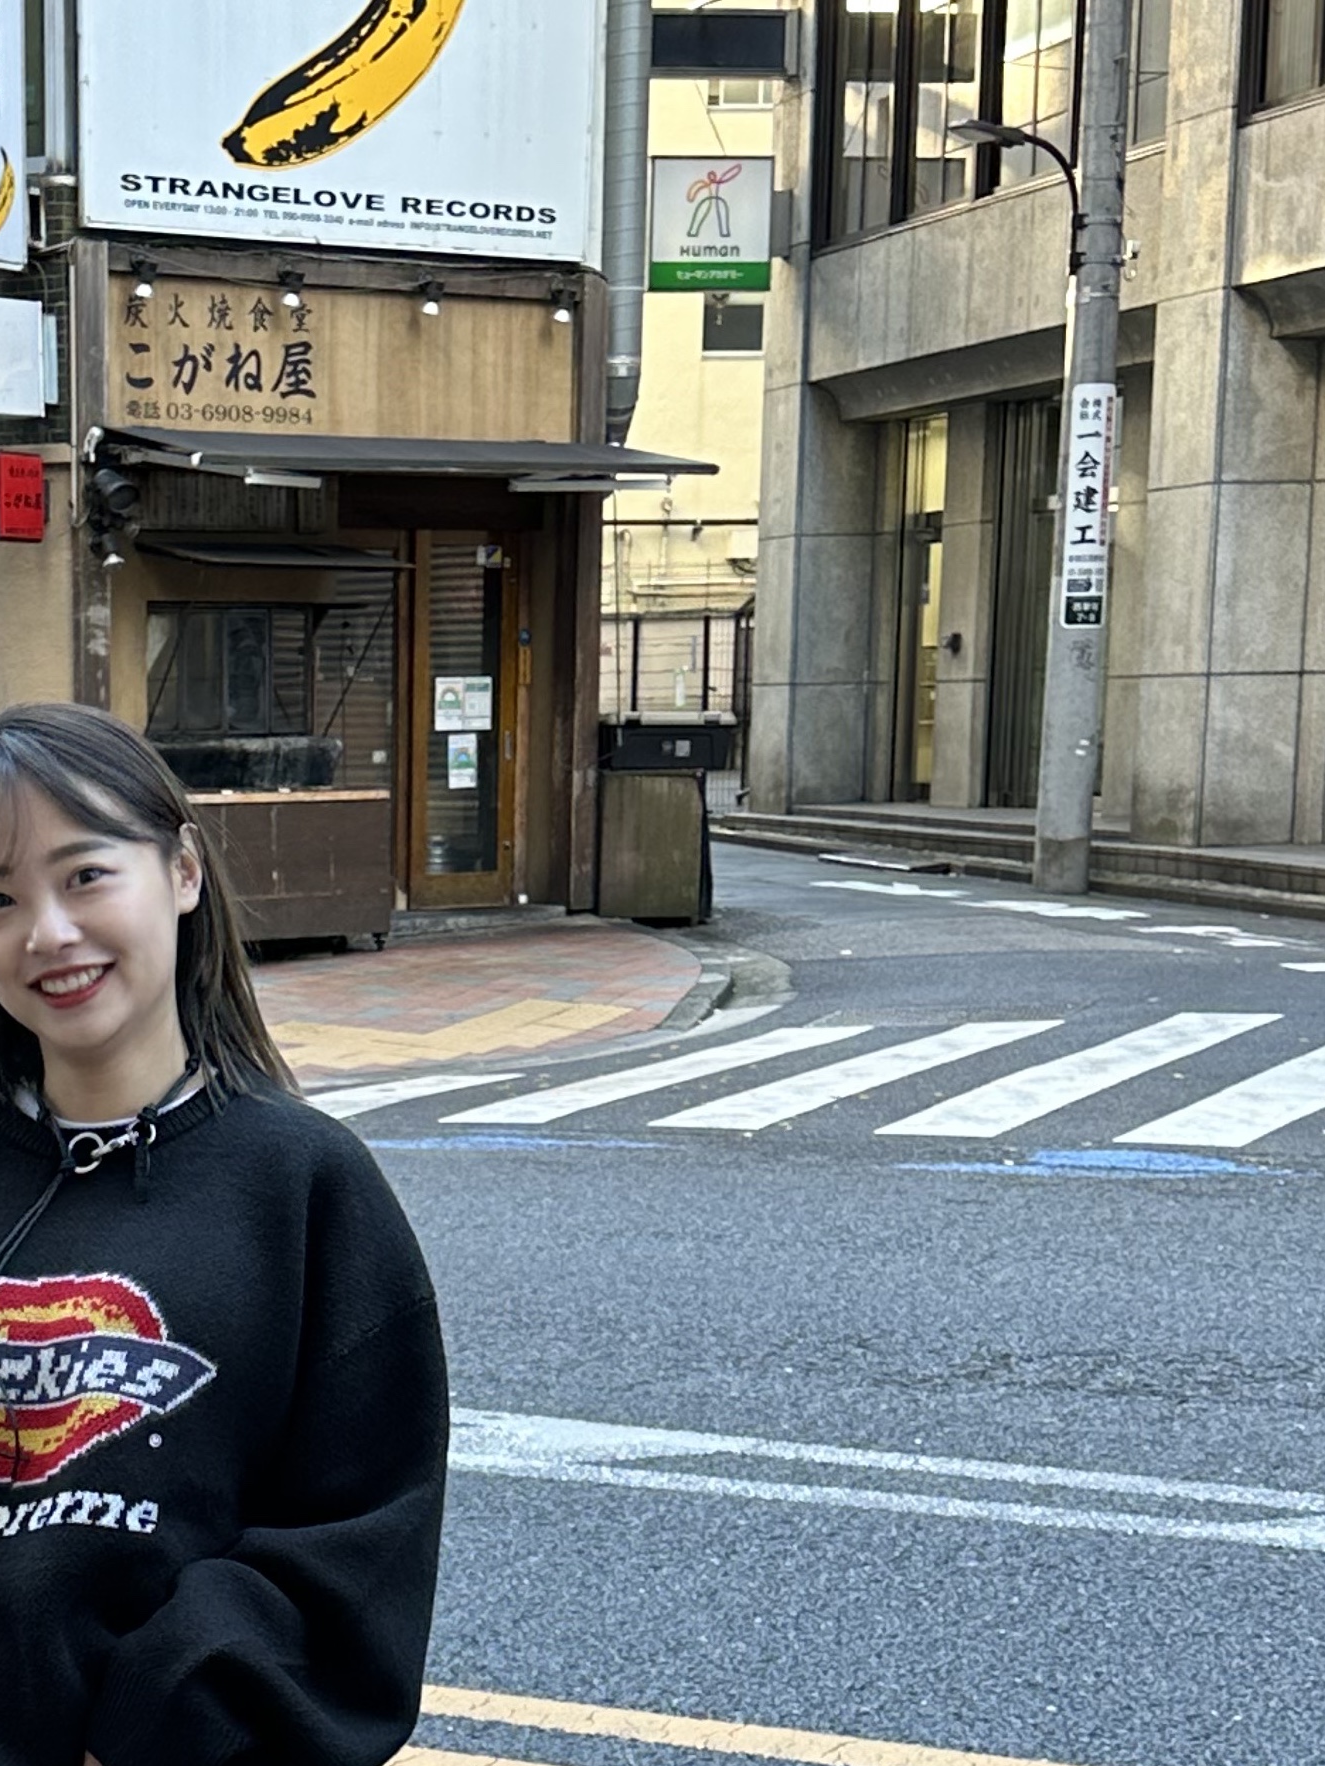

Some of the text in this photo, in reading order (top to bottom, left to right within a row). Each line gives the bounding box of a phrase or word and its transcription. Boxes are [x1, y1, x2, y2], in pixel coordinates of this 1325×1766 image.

[120, 174, 557, 224] STRANGELOVE RECORDS
[124, 199, 150, 209] OPEN
[152, 201, 200, 213] EVERYDAY
[263, 209, 280, 220] TEL
[124, 293, 314, 333] 炭火焼食堂
[126, 341, 316, 399] こがね屋
[126, 401, 313, 424] 電話 03-6908-9984
[1070, 431, 1103, 545] 一会建工
